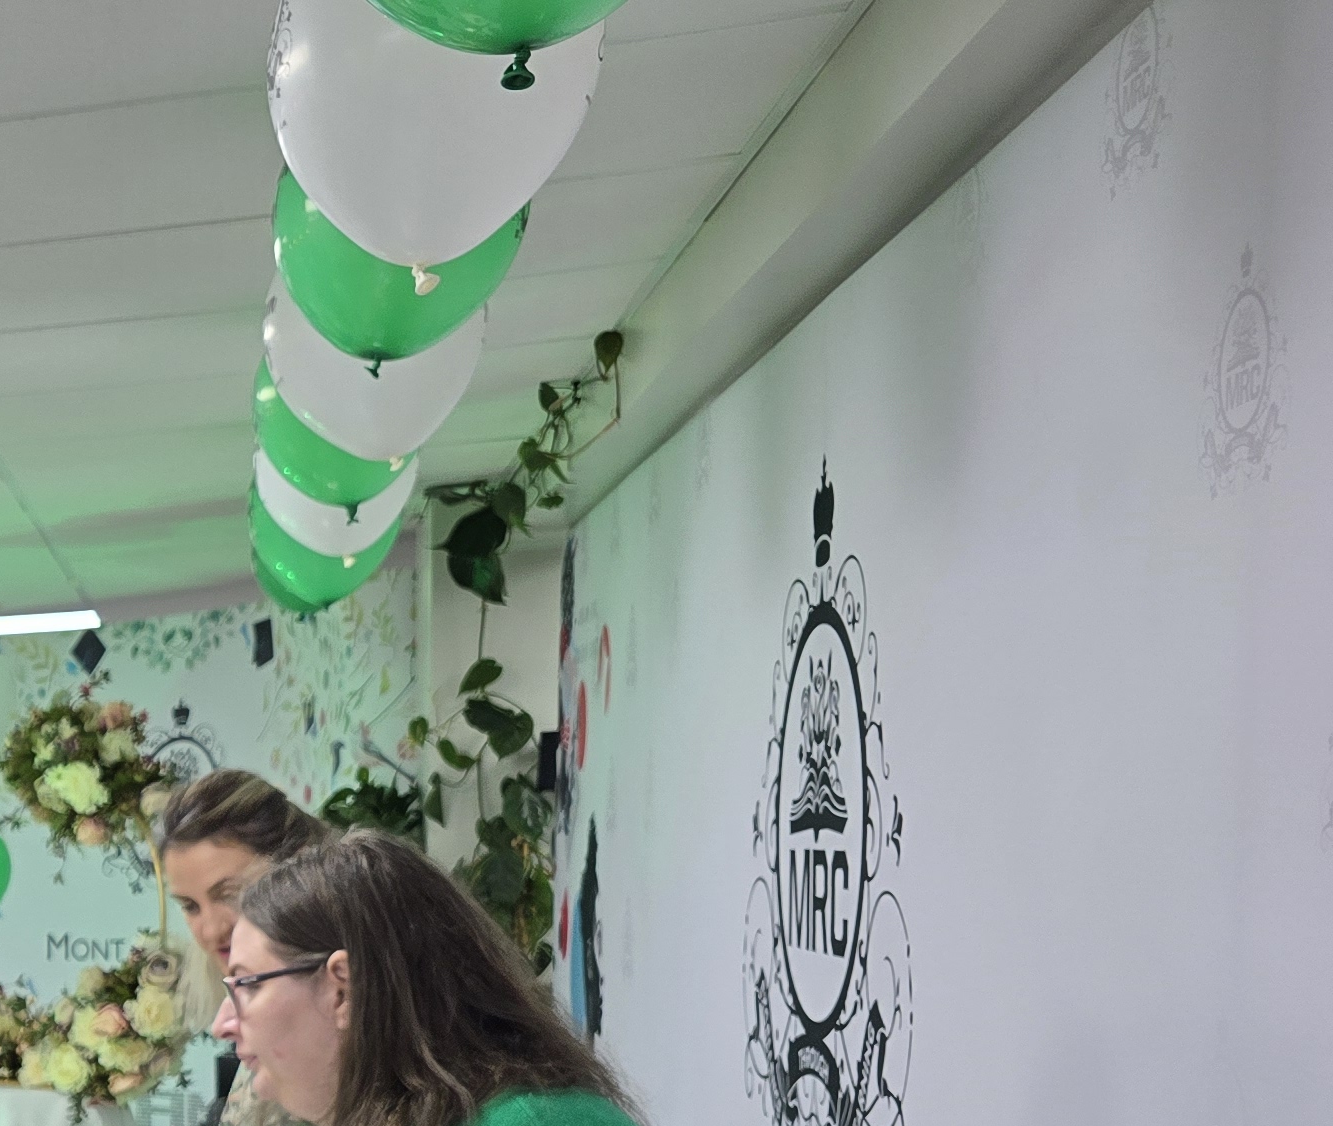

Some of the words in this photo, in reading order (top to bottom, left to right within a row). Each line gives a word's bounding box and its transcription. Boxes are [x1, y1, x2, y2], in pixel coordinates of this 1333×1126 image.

[1225, 364, 1261, 412] MRC
[789, 848, 849, 958] MRC
[46, 931, 125, 963] MONT
